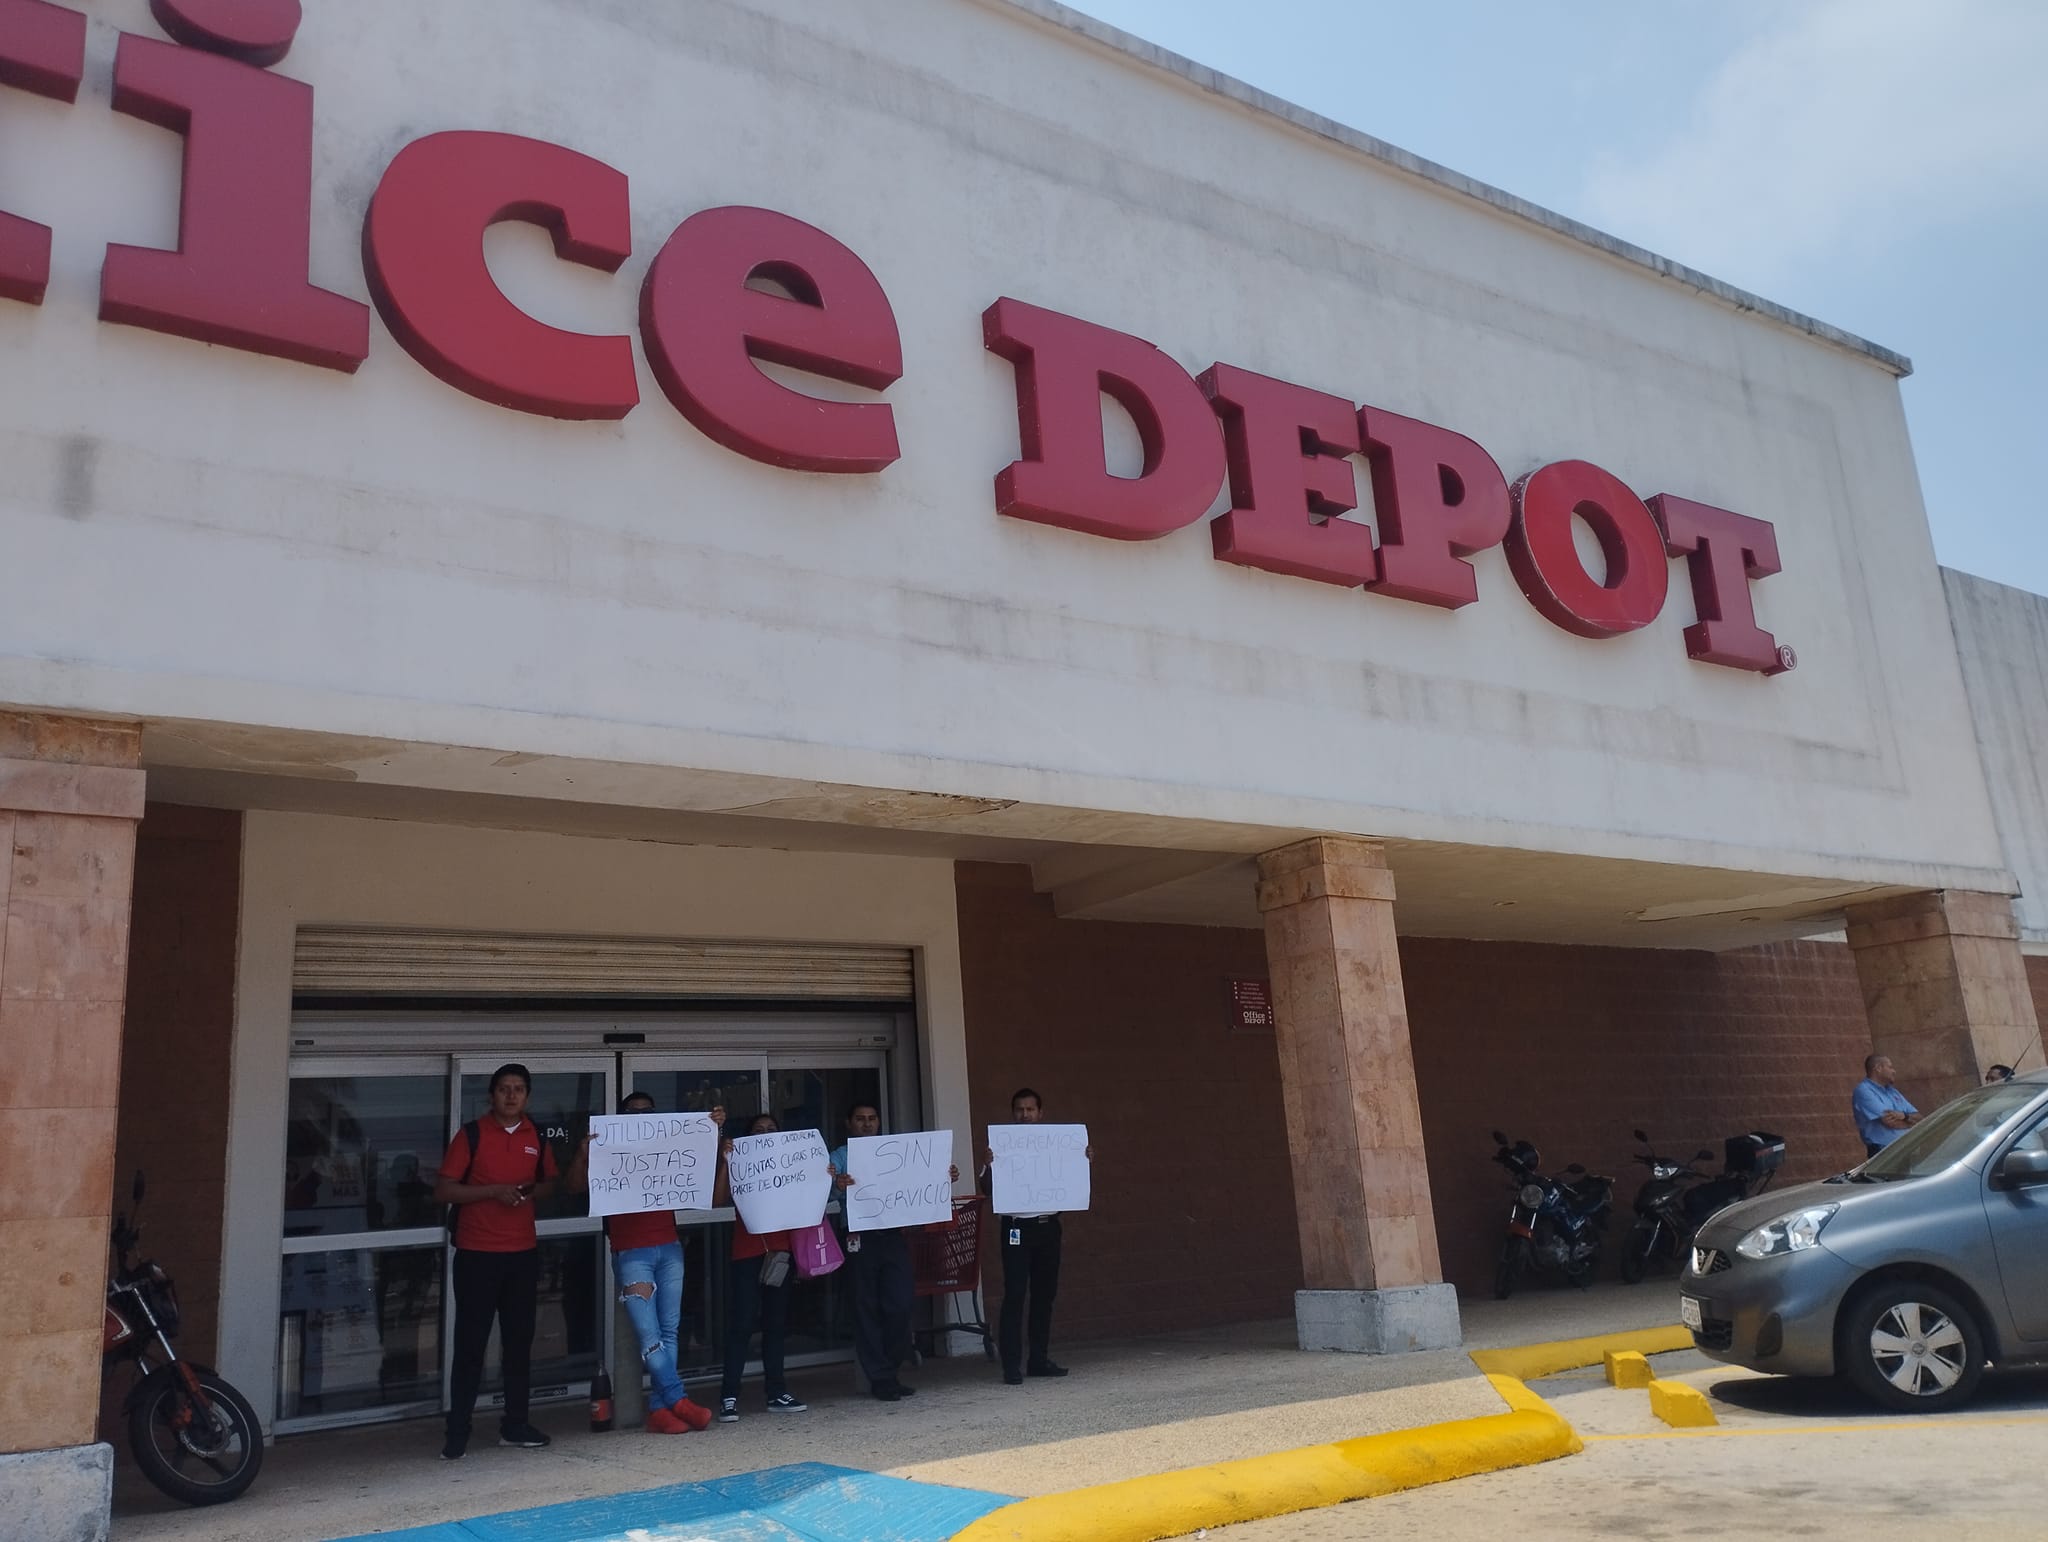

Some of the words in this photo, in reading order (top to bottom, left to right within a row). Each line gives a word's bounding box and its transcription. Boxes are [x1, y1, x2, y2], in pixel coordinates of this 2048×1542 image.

[594, 1118, 712, 1146] UTILIDADES
[730, 1141, 750, 1160] NO
[755, 1137, 775, 1150] MAS
[874, 1137, 932, 1176] SIN
[611, 1149, 697, 1176] JUSTAS
[730, 1157, 777, 1182] CUENTAS
[780, 1149, 807, 1169] CLARAS
[810, 1147, 825, 1160] POR
[591, 1176, 631, 1193] PARA
[641, 1173, 697, 1190] OFFICE
[732, 1182, 753, 1196] PARTE
[758, 1179, 772, 1192] DE
[642, 1190, 700, 1208] DEPOT
[854, 1181, 950, 1219] SERVICIO
